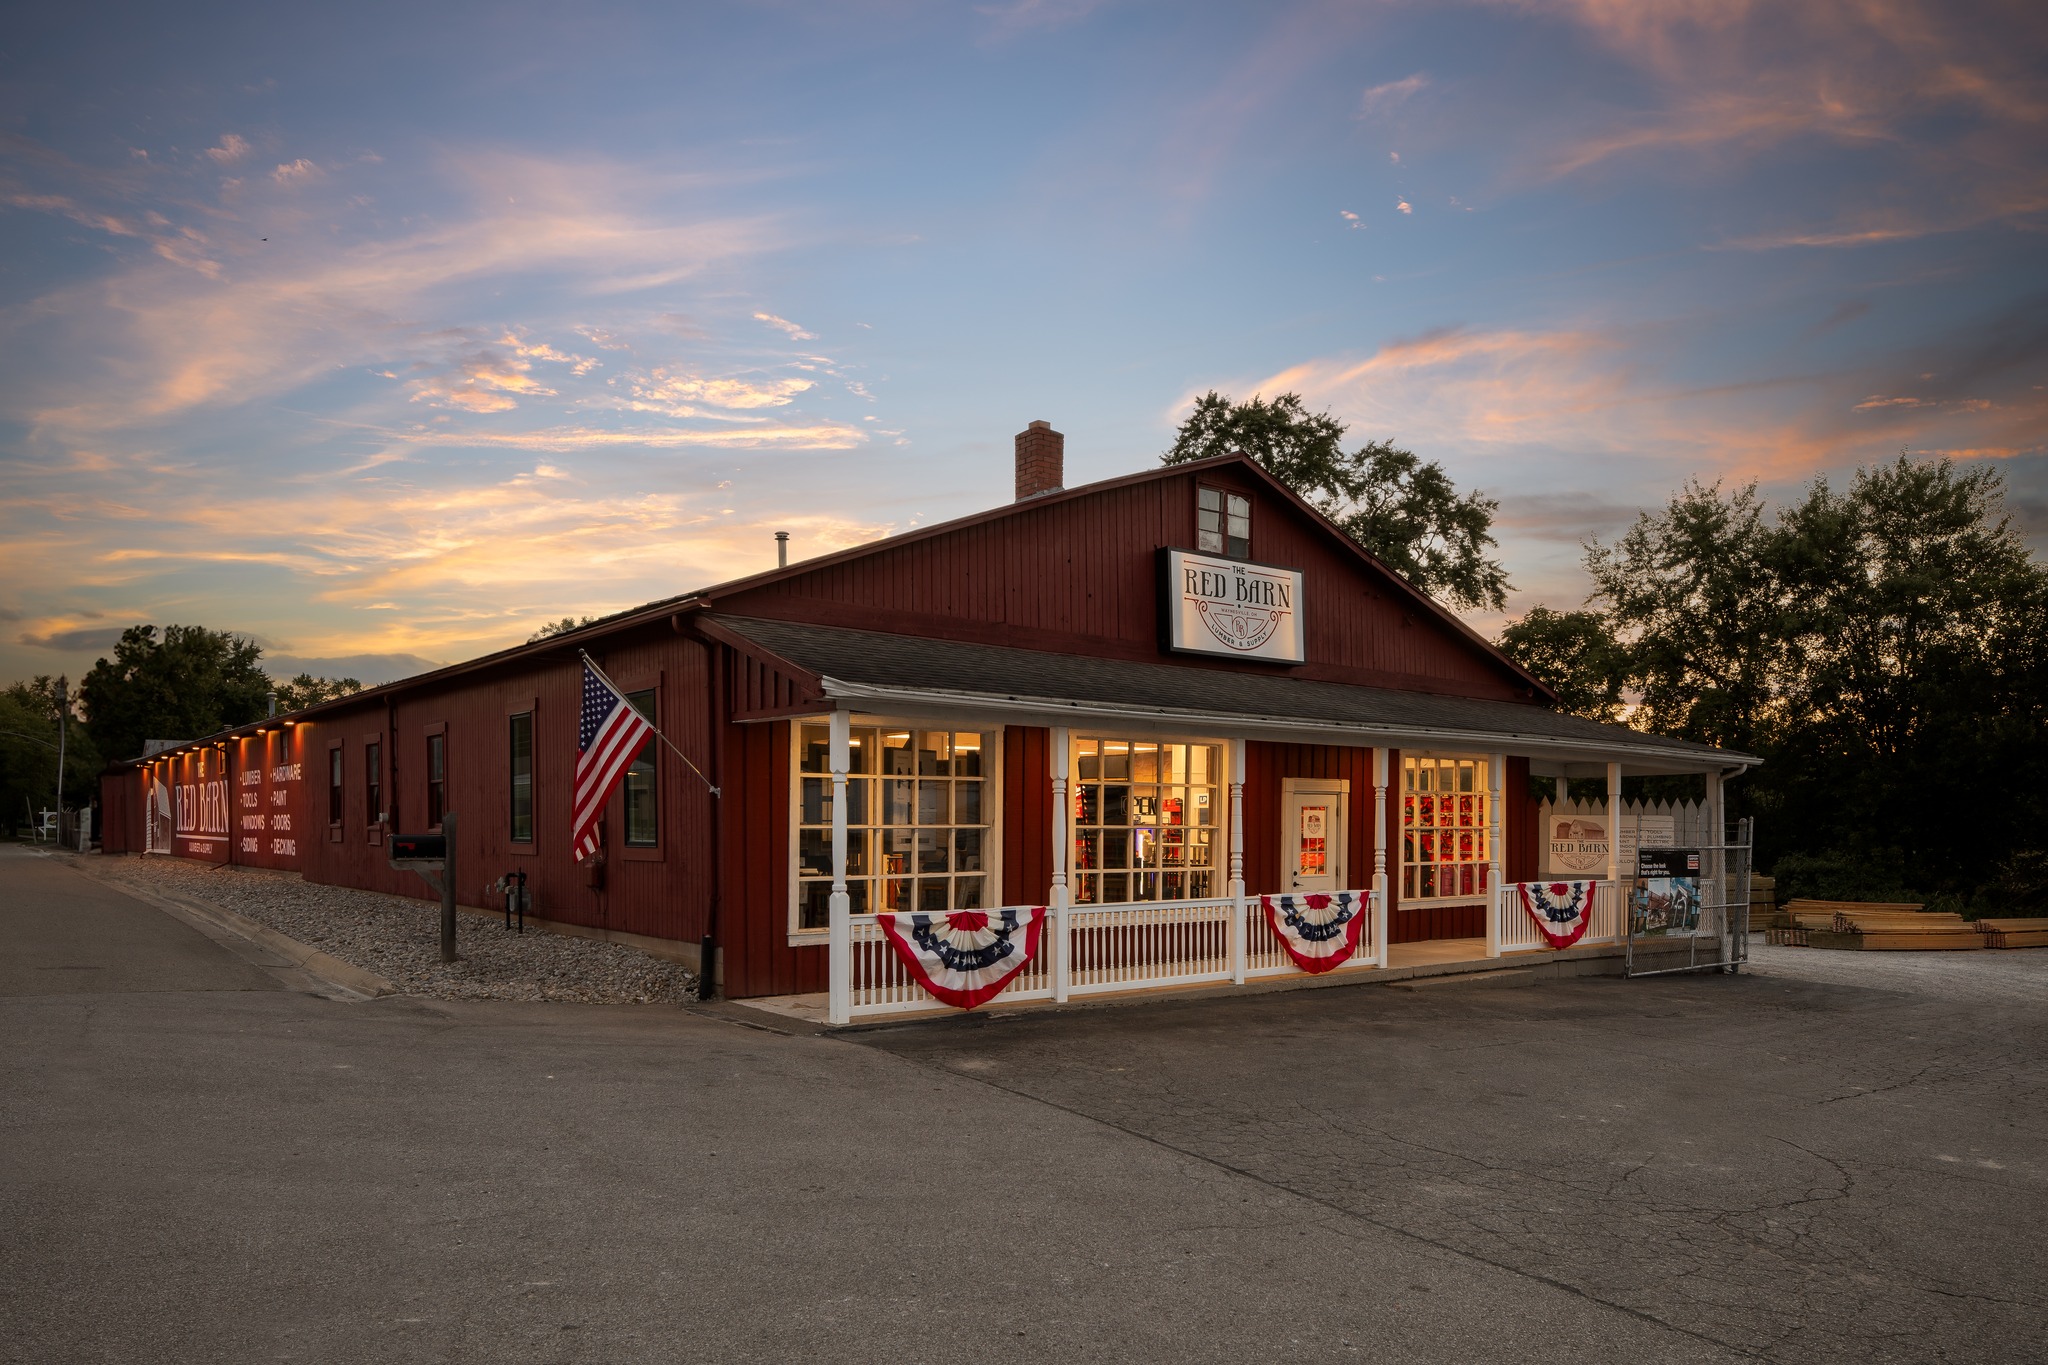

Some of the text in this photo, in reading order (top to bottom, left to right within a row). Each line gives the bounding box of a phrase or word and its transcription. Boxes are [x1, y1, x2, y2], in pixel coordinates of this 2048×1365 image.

[1232, 566, 1246, 576] THE
[1184, 568, 1291, 608] RED BARN
[1212, 624, 1234, 645] LUMBER
[1246, 631, 1267, 646] SUPPLY
[242, 770, 261, 786] LUMBER
[272, 764, 301, 782] HARDWARE
[176, 780, 229, 832] RED BARN
[242, 792, 258, 808] TOOLS
[274, 790, 286, 806] PAINT
[242, 814, 264, 830] WINDOWS
[274, 814, 290, 830] DOORS
[242, 837, 258, 852] SIDING
[274, 838, 296, 856] DECKING
[1551, 843, 1609, 852] RED BARN
